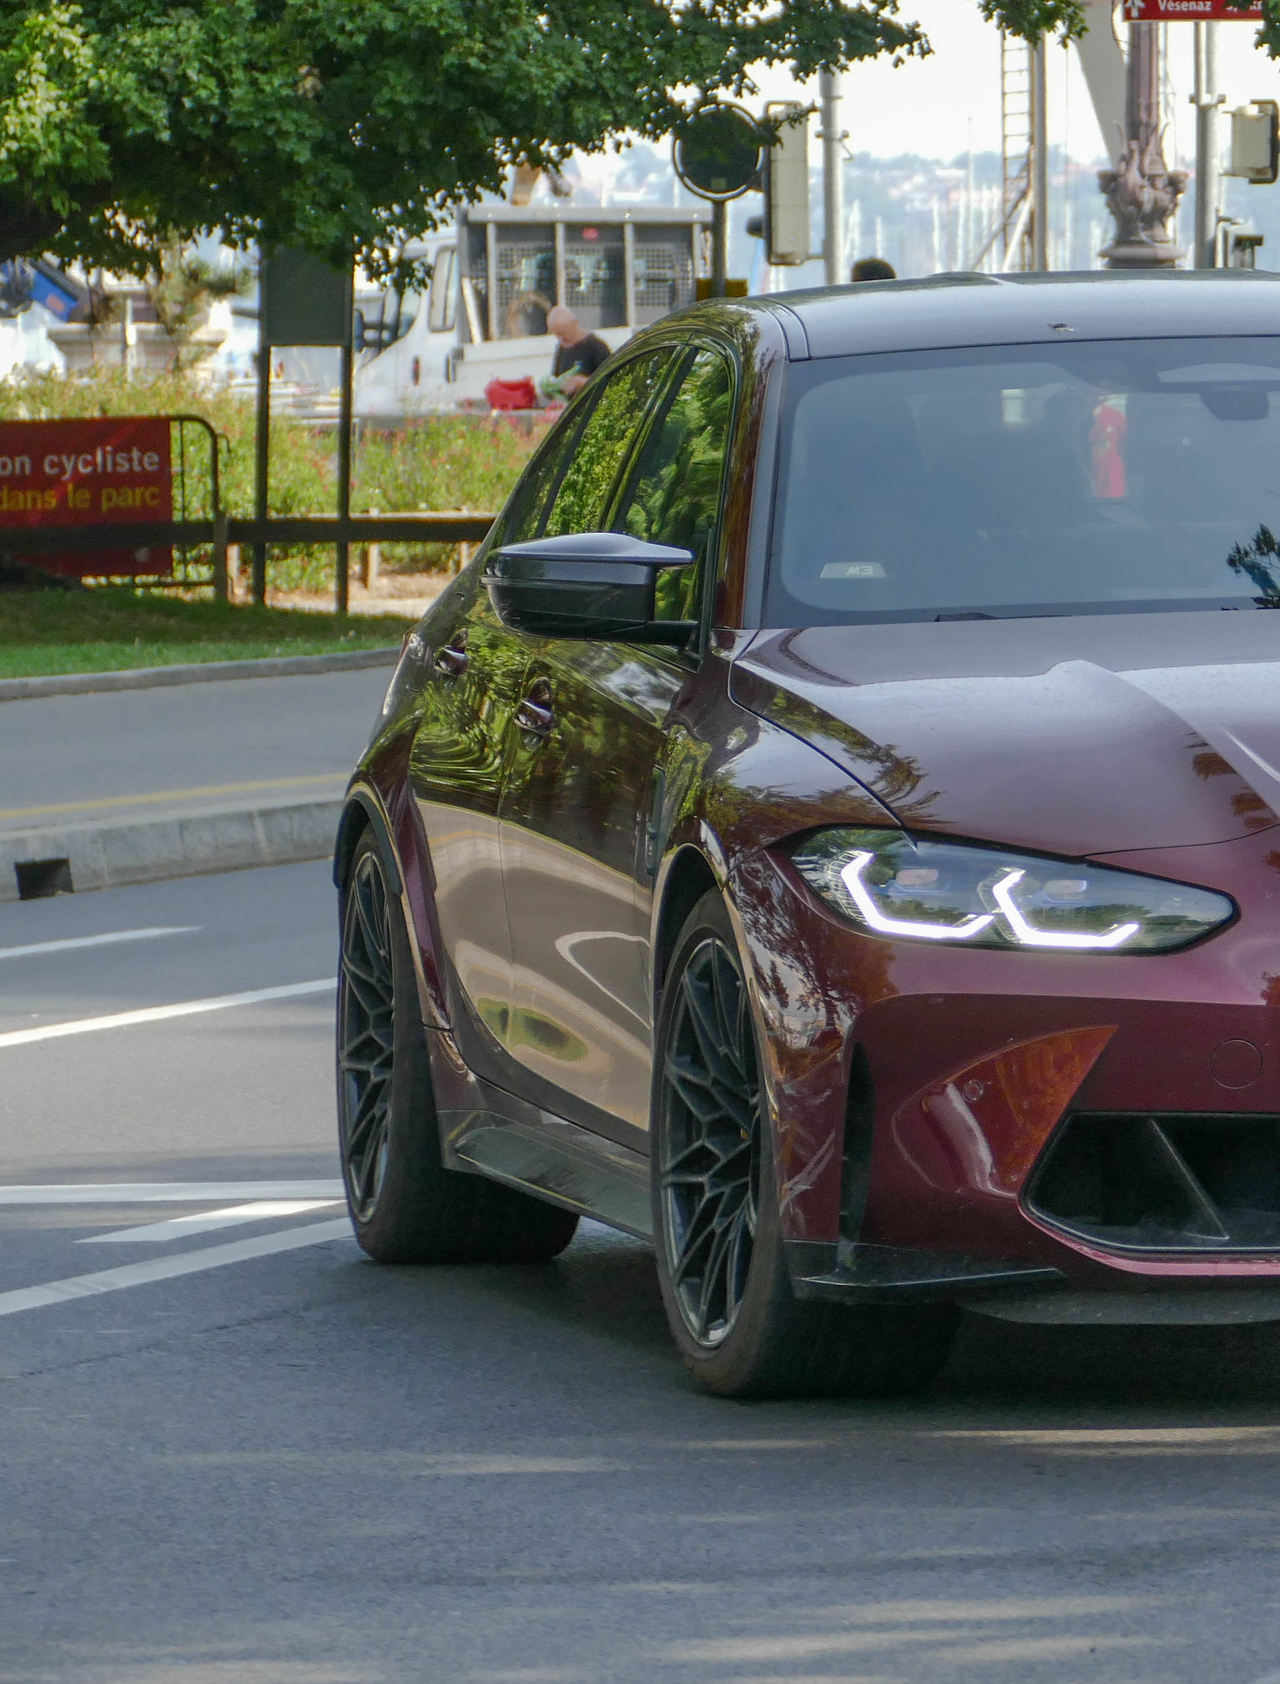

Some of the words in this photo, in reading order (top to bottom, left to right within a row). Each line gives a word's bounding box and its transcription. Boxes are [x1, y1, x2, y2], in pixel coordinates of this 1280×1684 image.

[43, 446, 160, 481] cycliste
[67, 482, 91, 509] le
[101, 486, 161, 514] parc
